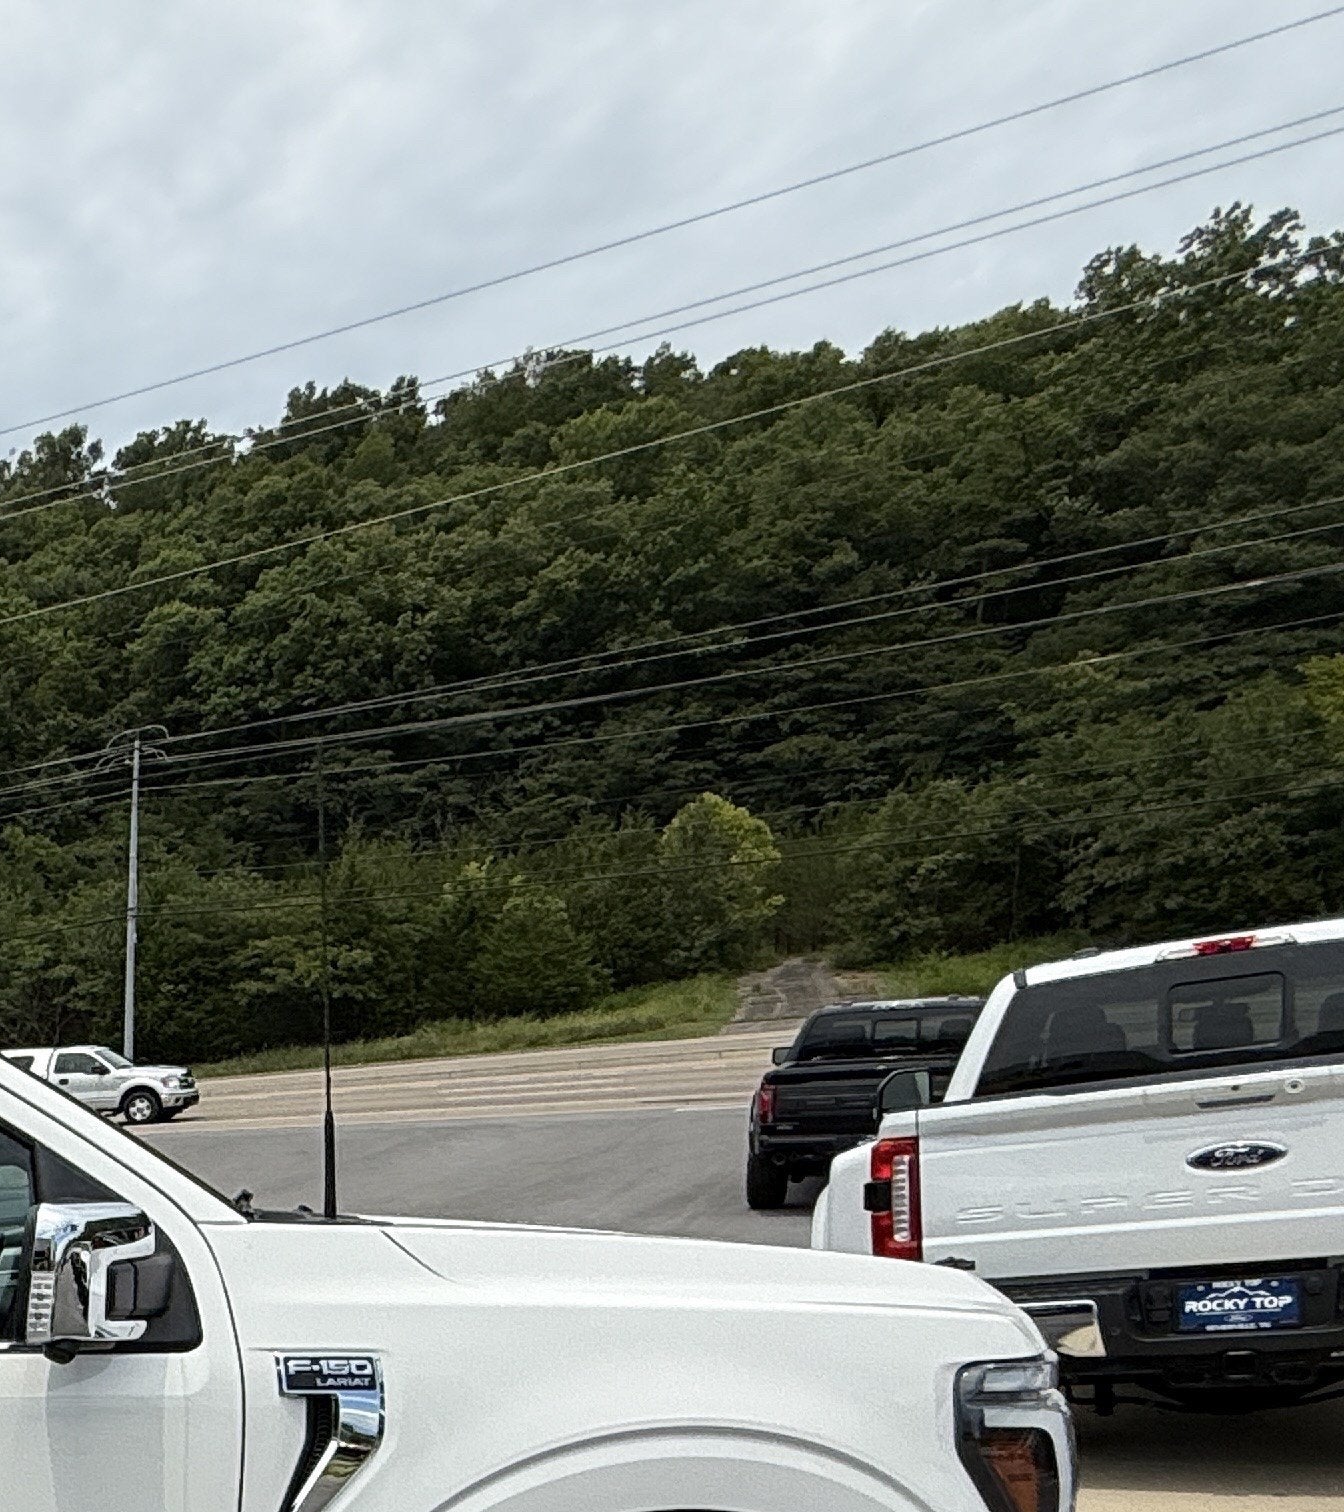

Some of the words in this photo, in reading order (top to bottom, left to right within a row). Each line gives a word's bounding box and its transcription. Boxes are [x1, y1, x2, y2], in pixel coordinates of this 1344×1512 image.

[957, 1184, 1261, 1224] SUPER
[1184, 1298, 1249, 1313] ROCKY
[1251, 1295, 1293, 1309] TOP
[286, 1359, 374, 1376] F-150
[315, 1377, 372, 1387] LARIAT
